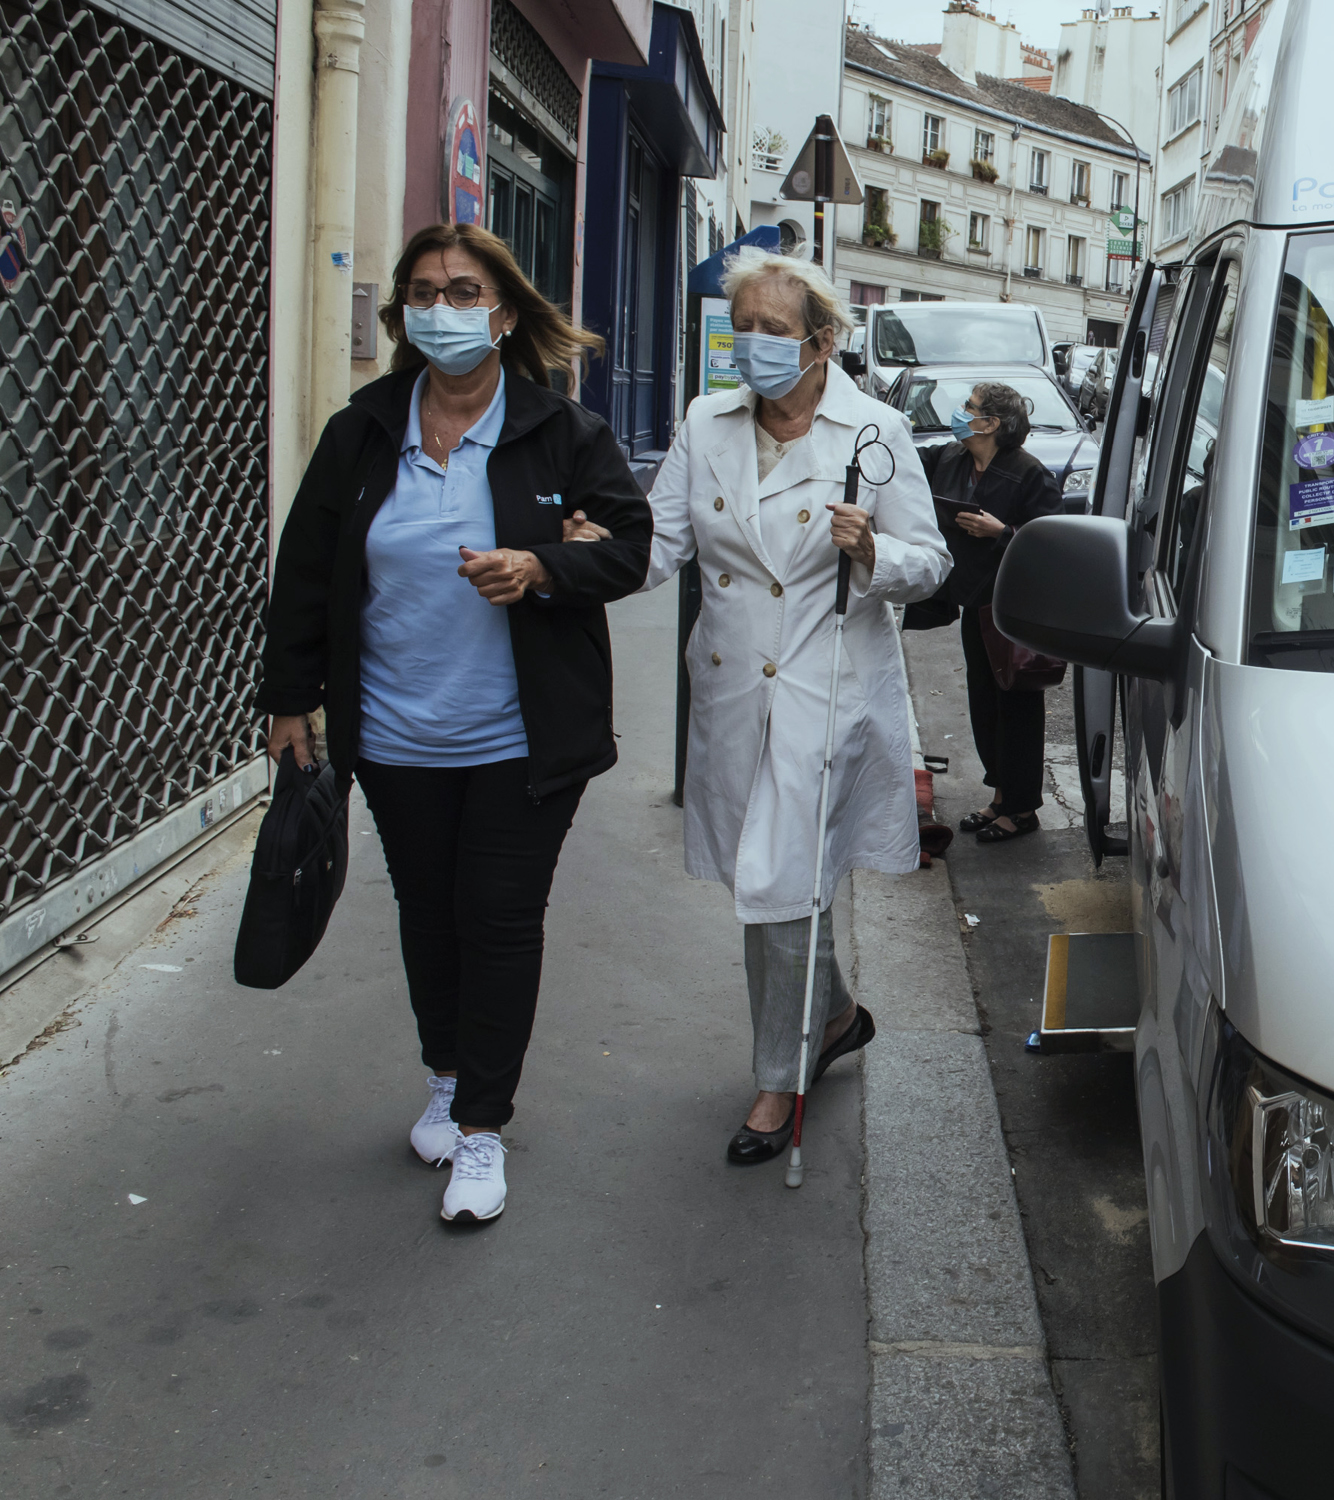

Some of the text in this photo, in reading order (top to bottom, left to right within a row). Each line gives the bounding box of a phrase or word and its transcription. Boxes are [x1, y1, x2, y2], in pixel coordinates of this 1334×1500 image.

[1292, 204, 1307, 212] La
[536, 494, 553, 502] Pam
[1301, 490, 1330, 499] COLLECTIF
